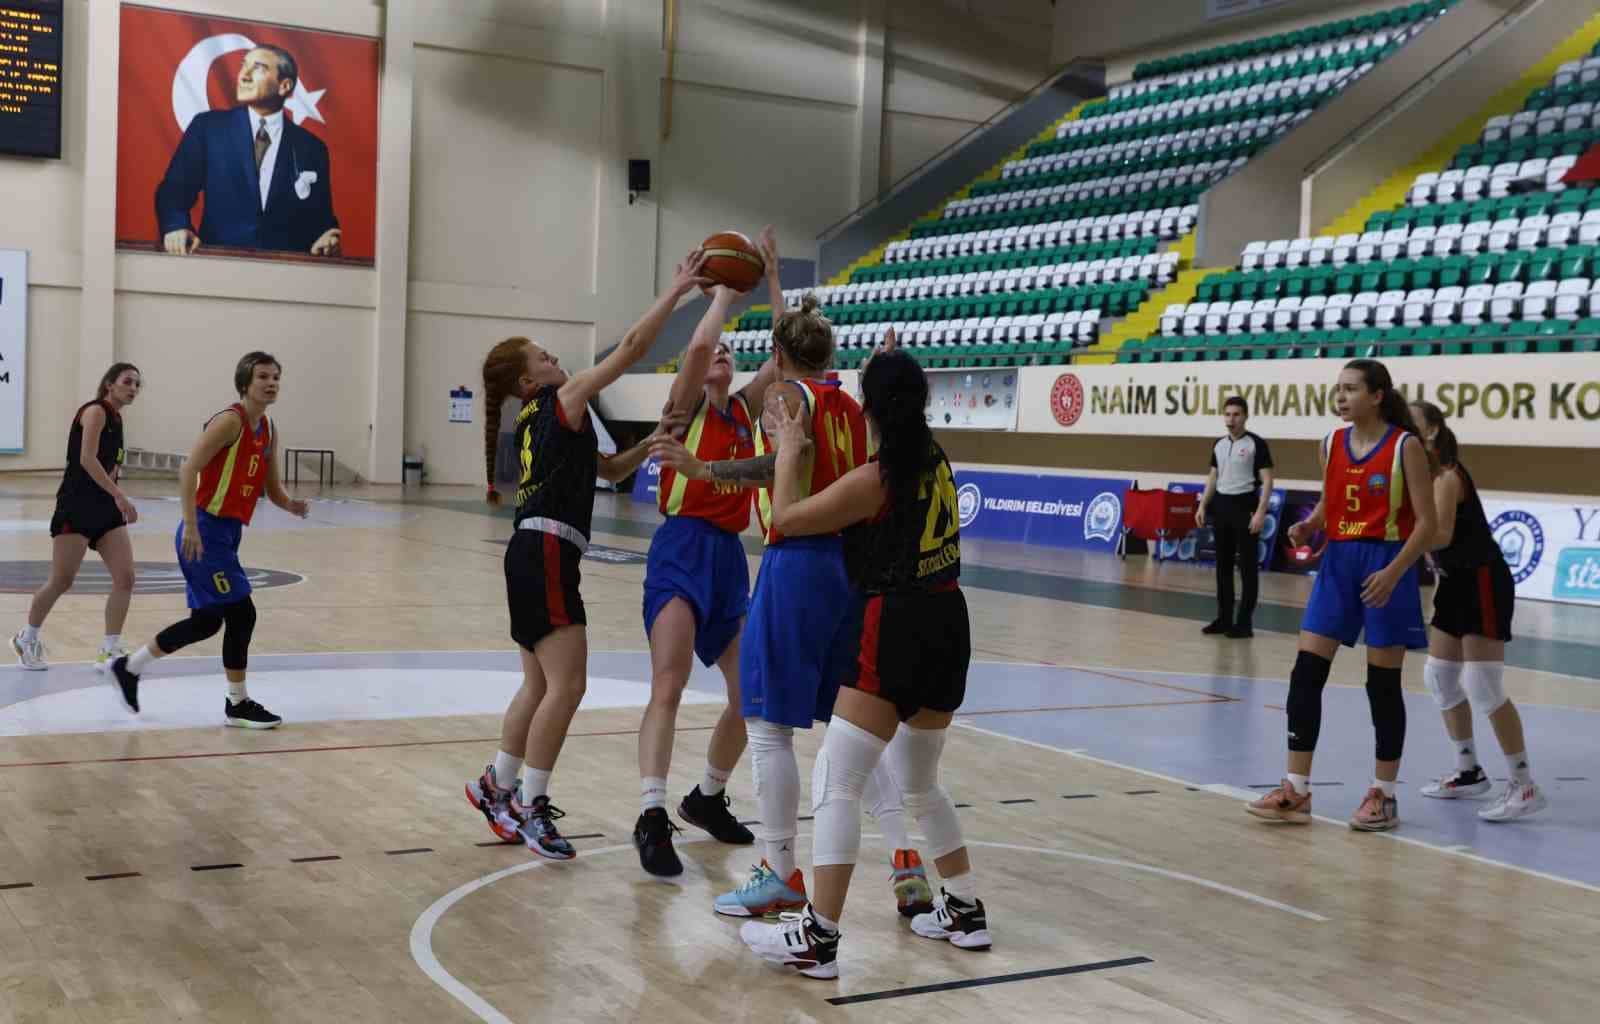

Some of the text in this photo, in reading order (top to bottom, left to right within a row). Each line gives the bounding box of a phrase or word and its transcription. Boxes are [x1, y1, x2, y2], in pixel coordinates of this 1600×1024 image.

[1091, 377, 1157, 415] NAİM
[1436, 382, 1536, 420] SPOR
[984, 497, 1025, 513] YILDIRIM
[1026, 499, 1084, 518] BELEDİYESİ
[1345, 484, 1361, 512] 5
[1573, 507, 1600, 541] Y
[212, 571, 231, 594] 6
